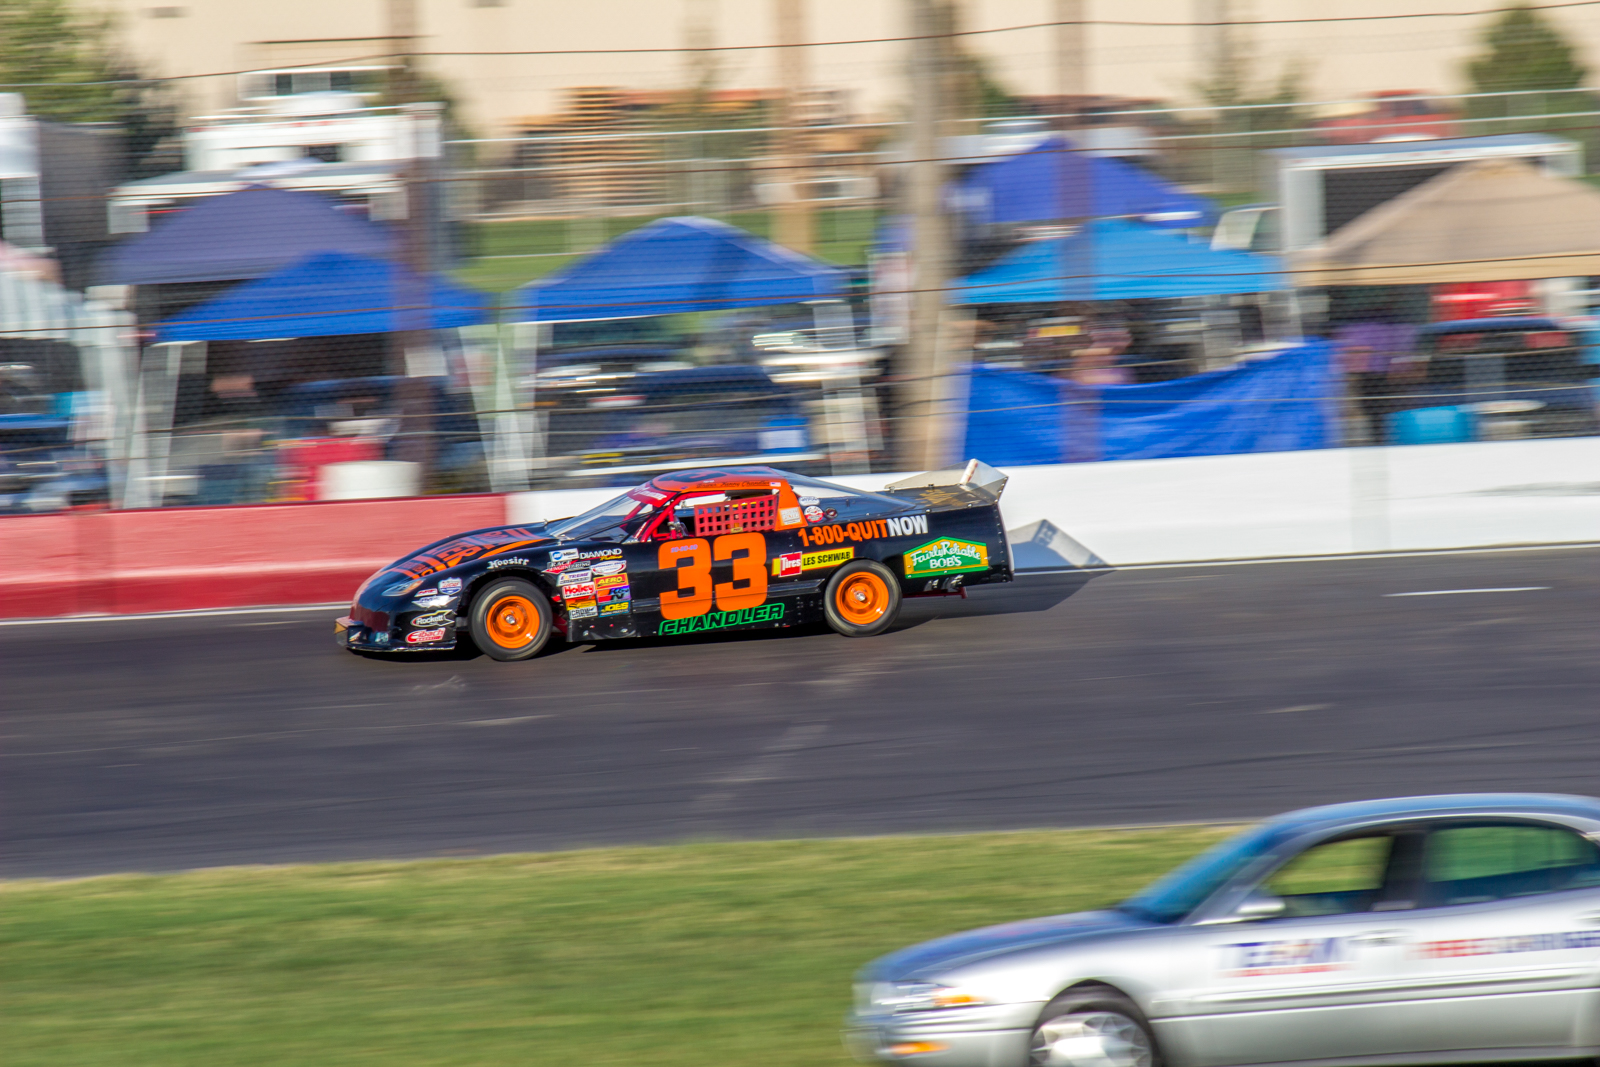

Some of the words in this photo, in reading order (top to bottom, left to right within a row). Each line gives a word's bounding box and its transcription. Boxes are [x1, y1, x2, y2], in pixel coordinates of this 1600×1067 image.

[580, 548, 622, 559] DIAMOND
[780, 556, 800, 571] Tires
[802, 556, 816, 566] LES
[817, 551, 851, 564] SCHWAB
[597, 576, 623, 585] AERO
[658, 532, 768, 620] 33
[564, 584, 594, 595] Holley
[601, 602, 629, 613] JOES
[658, 602, 785, 636] CHANDLER
